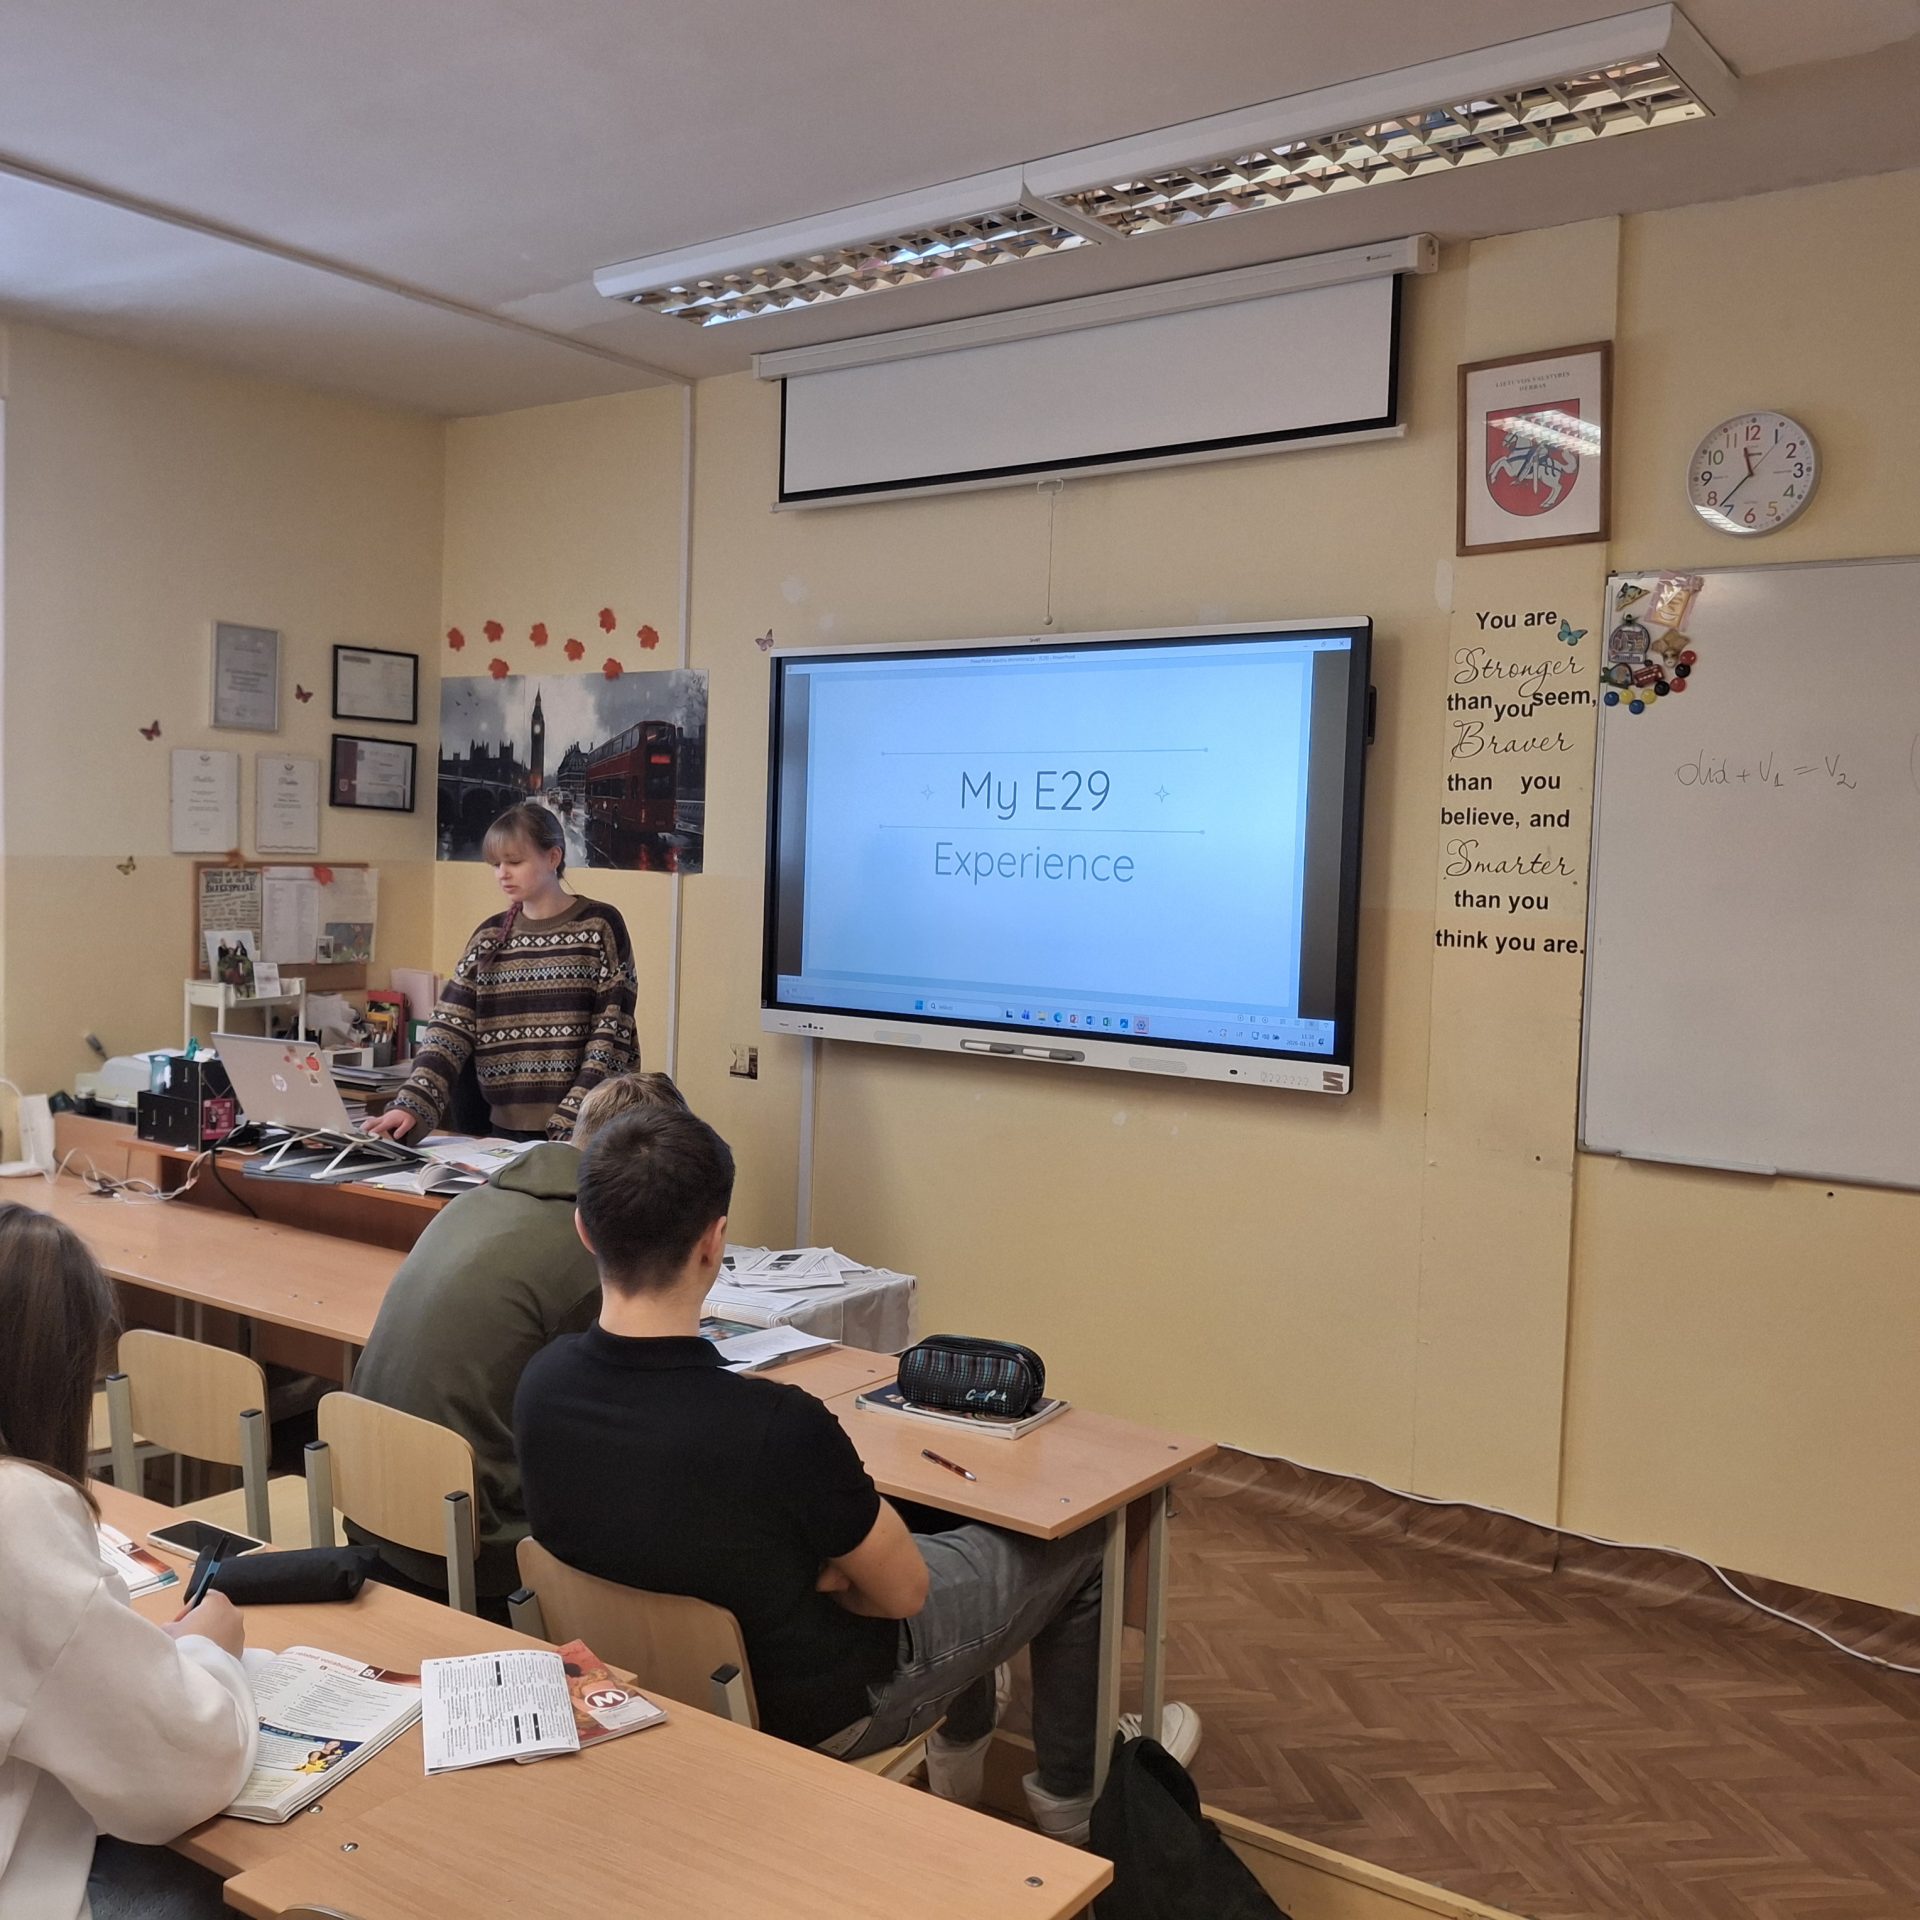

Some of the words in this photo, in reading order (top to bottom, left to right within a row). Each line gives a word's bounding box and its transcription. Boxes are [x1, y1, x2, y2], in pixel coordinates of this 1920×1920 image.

[1725, 432, 1738, 449] 11
[1745, 424, 1761, 442] 12
[1774, 428, 1779, 445] 1
[1707, 449, 1724, 466] 10
[1785, 442, 1797, 459] 2
[1700, 470, 1713, 487] 9
[1792, 462, 1804, 479] 3
[1706, 490, 1718, 507] 8
[1782, 484, 1795, 498] 4
[1723, 504, 1735, 518] 7
[1744, 507, 1756, 524] 6
[1766, 501, 1778, 518] 5
[1475, 611, 1517, 631] You
[1523, 610, 1558, 627] are
[1453, 647, 1585, 698] Stronger
[1446, 692, 1492, 712] than
[1493, 703, 1536, 723] you
[1531, 688, 1598, 708] seem,
[1449, 719, 1575, 761] Braver
[1447, 773, 1493, 792] than
[1520, 775, 1561, 795] you
[961, 771, 1017, 821] My
[1035, 770, 1110, 812] E29
[1440, 806, 1521, 831] believe,
[1529, 809, 1570, 828] and
[935, 841, 1135, 886] Experience
[1445, 838, 1576, 877] Smarter
[1454, 889, 1501, 909] than
[1508, 895, 1549, 914] you
[1435, 928, 1489, 949] think
[1495, 936, 1536, 955] you
[1543, 938, 1584, 955] are.
